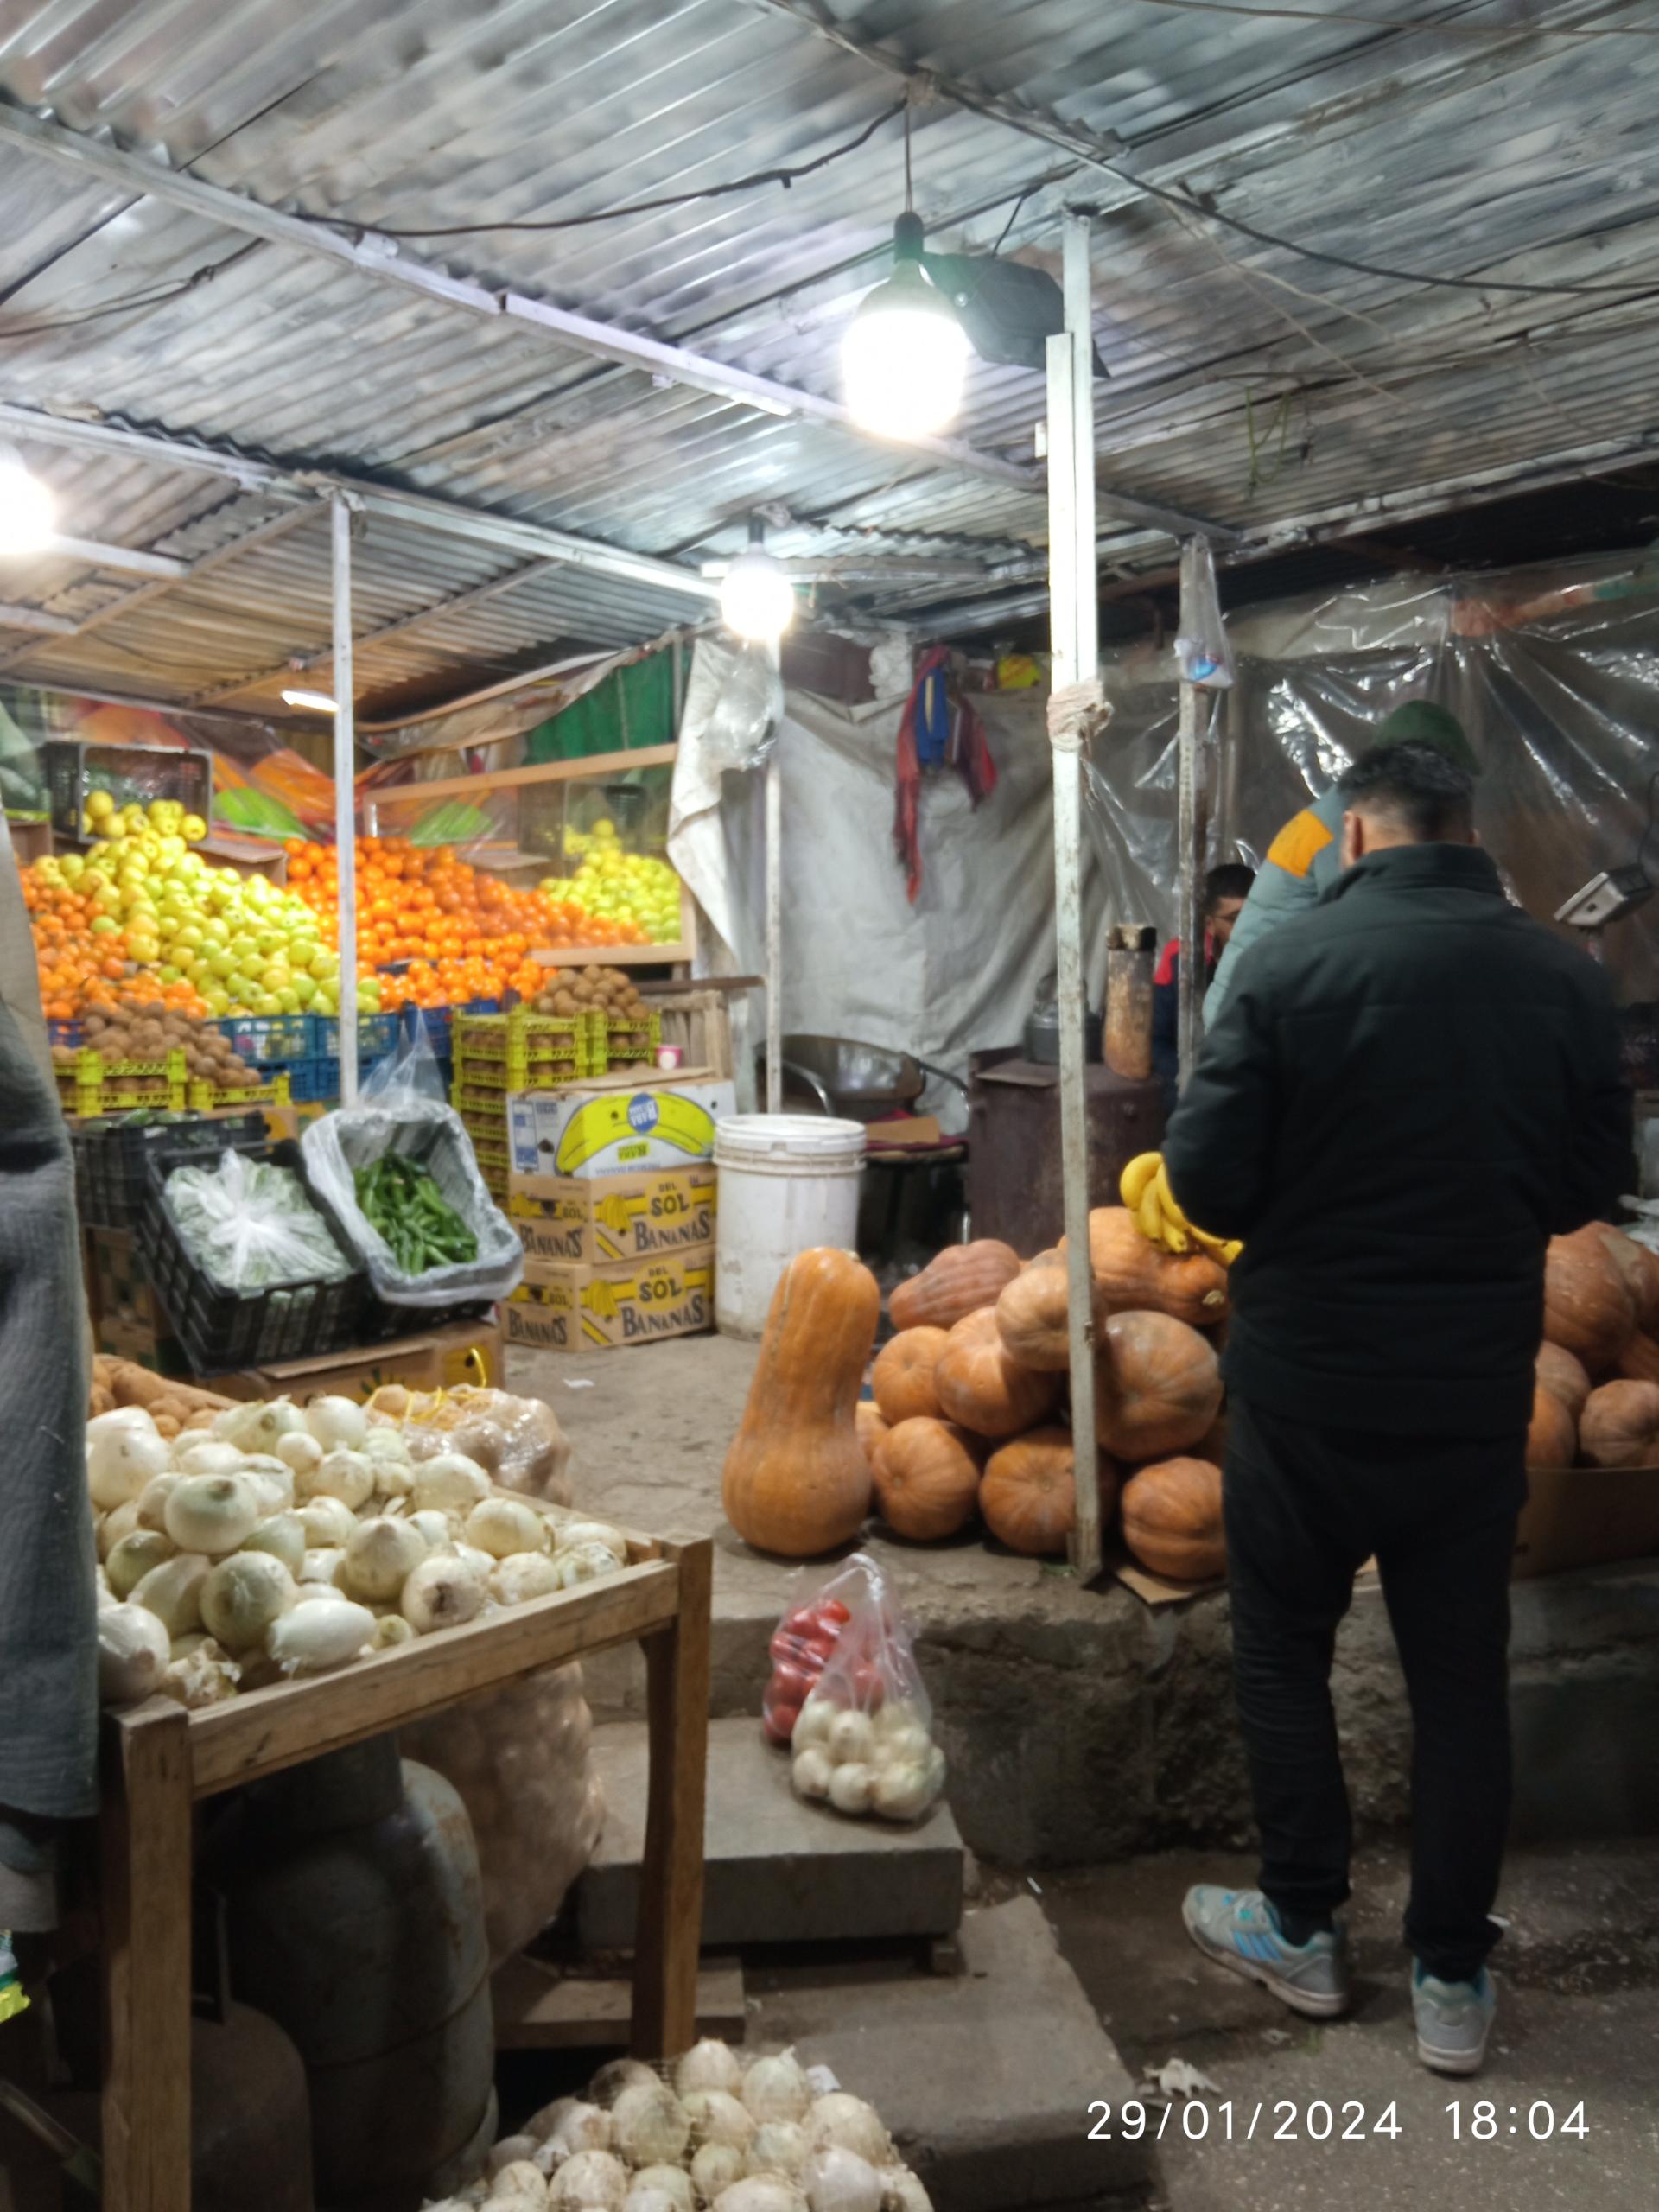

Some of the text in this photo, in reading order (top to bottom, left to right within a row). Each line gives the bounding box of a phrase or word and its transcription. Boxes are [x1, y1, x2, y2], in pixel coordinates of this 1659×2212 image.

[658, 1181, 677, 1192] DEL
[651, 1192, 690, 1217] SOL
[519, 1223, 584, 1258] BANANAS
[635, 1209, 711, 1252] BANANAS
[639, 1277, 682, 1302] SOL
[508, 1307, 568, 1345] BANANAS
[621, 1294, 706, 1338] BANANAS
